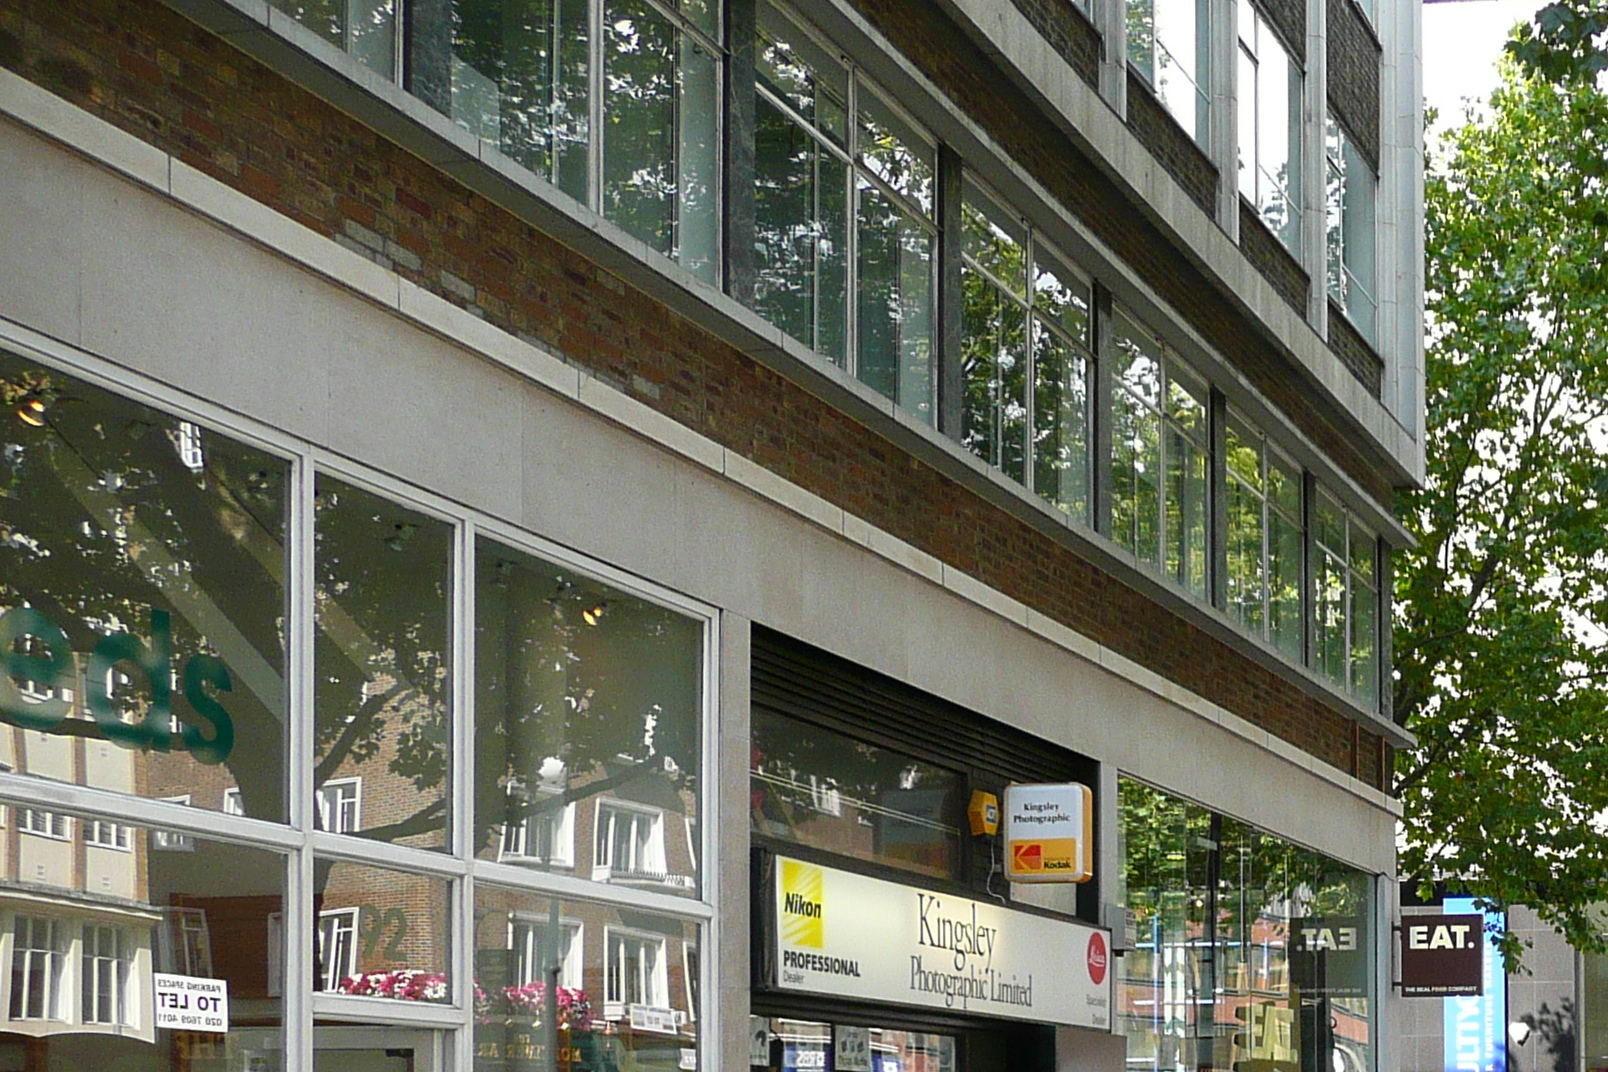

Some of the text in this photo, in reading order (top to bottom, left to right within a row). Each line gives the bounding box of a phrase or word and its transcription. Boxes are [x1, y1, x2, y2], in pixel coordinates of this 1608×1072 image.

[1013, 813, 1071, 824] Photographic
[1023, 802, 1059, 812] Kingsley
[1043, 861, 1071, 869] Kodak
[784, 892, 822, 918] Nikon
[360, 903, 408, 961] 92
[917, 893, 997, 974] Kingsley
[1409, 925, 1475, 950] EAT.
[783, 950, 861, 977] PROFESSIONAL
[783, 970, 805, 984] Dealer
[910, 955, 1032, 1008] Photographic Limited
